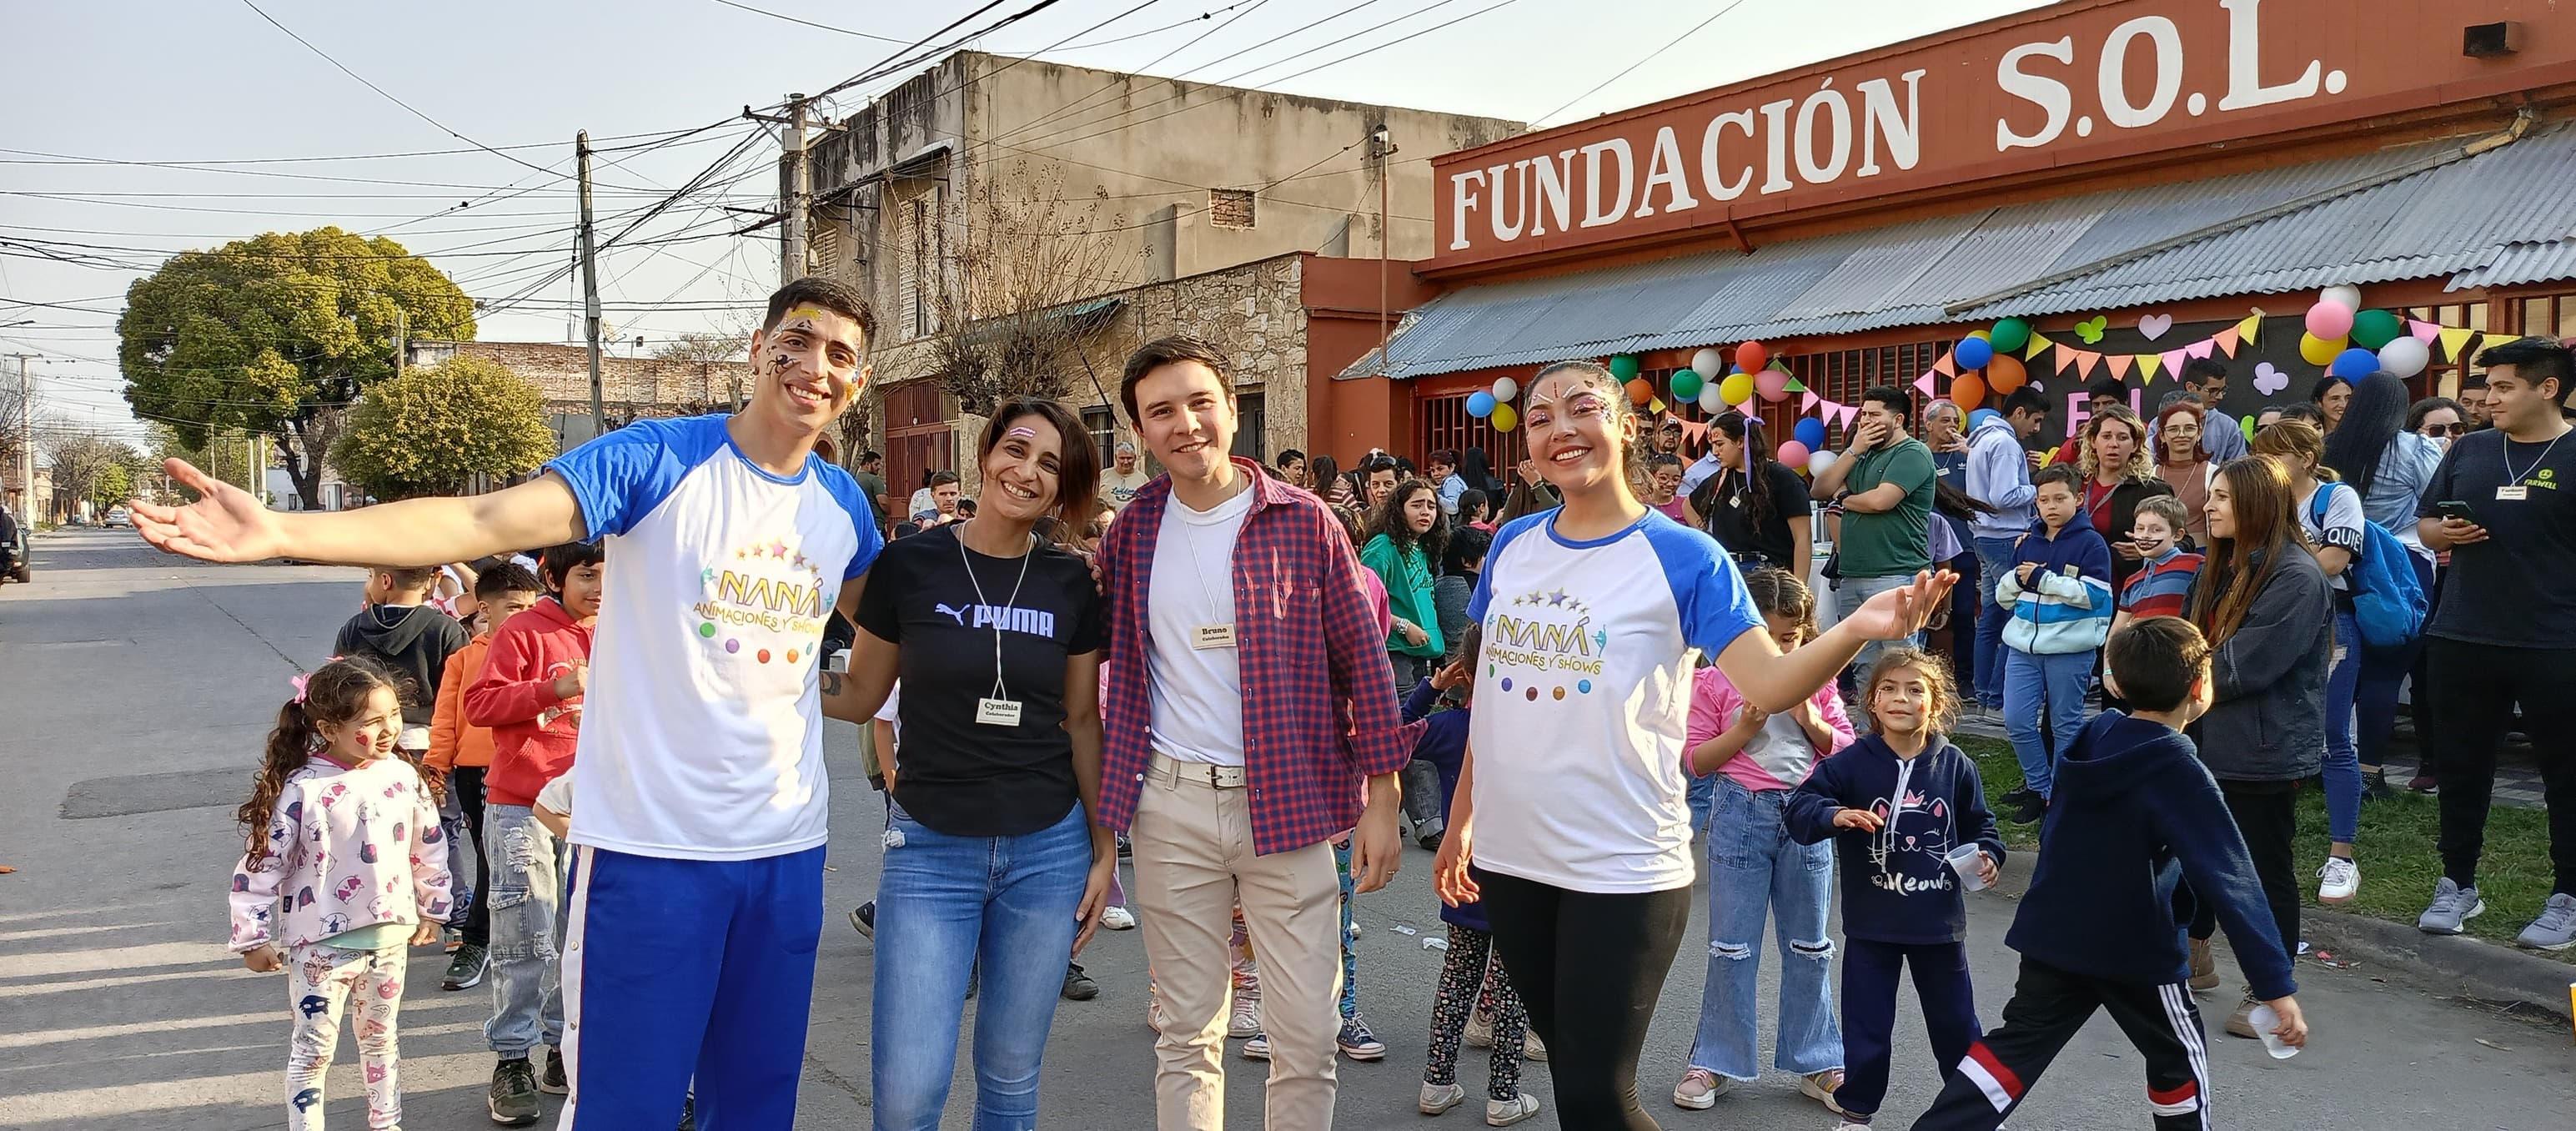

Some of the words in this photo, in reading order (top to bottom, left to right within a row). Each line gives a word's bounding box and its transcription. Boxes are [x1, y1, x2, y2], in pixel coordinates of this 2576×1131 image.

[1449, 68, 1926, 251] FUNDACIÓN
[1996, 0, 2348, 152] S.O.L.
[2523, 479, 2558, 490] FARWELL
[719, 571, 824, 618] NANÁ
[694, 600, 781, 633] ANIMACIONES
[782, 616, 799, 629] Y
[973, 605, 1054, 638] PUMA
[1496, 614, 1590, 656] NANÁ
[1549, 654, 1564, 668] Y
[1558, 656, 1604, 676] SHOWS
[984, 701, 1018, 711] Cynthia
[1883, 872, 1945, 897] Meow
